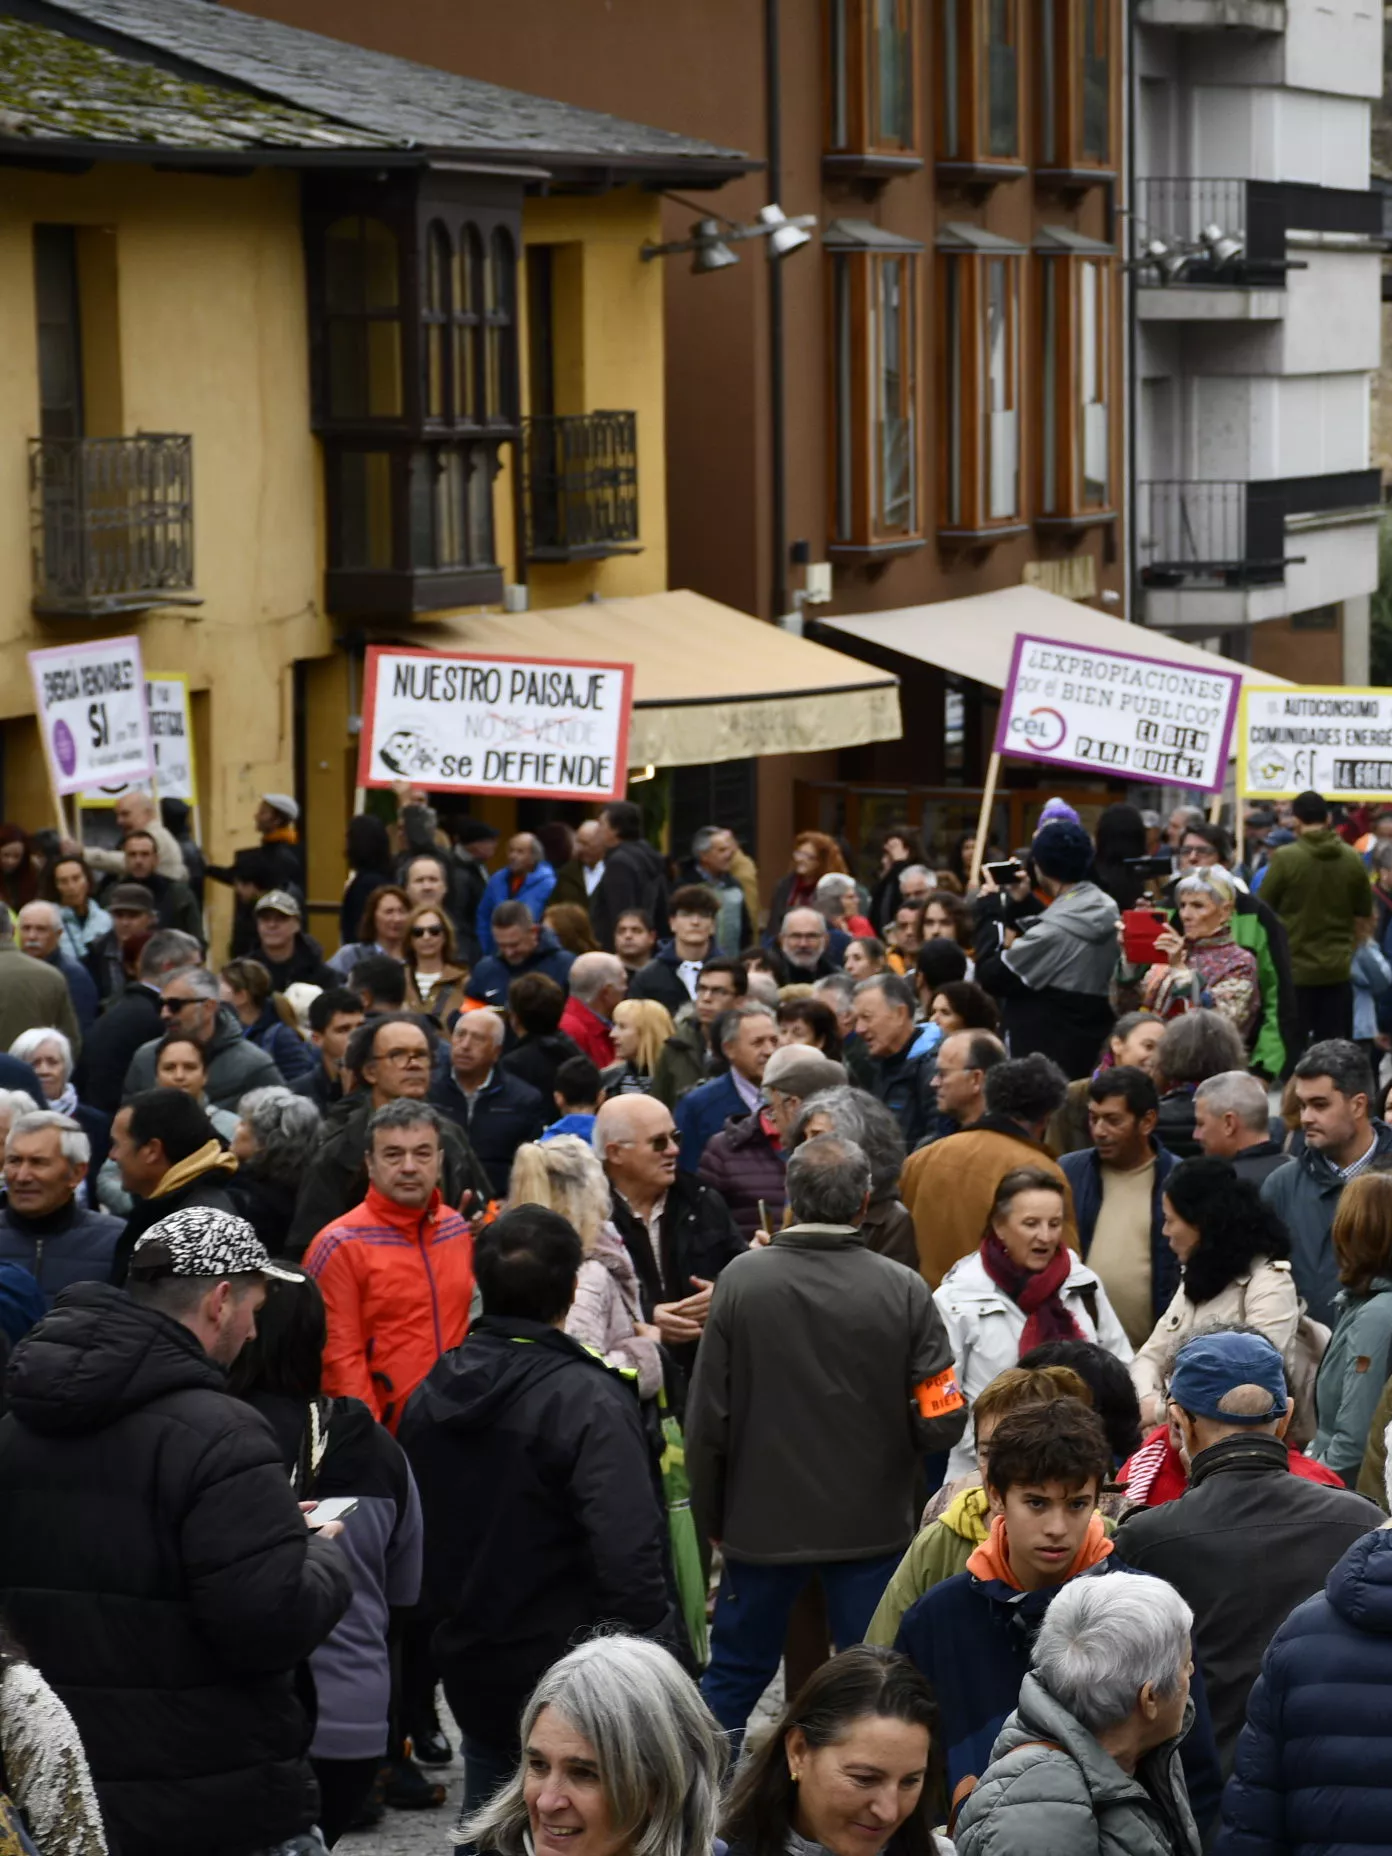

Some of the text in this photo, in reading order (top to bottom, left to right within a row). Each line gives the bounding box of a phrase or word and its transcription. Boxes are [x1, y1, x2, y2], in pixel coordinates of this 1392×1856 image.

[393, 663, 605, 710] NUESTRO PAISAJE
[1028, 649, 1225, 701] ¿EXPROPIACIONES
[1061, 682, 1114, 708] BIEN
[1284, 697, 1379, 718] AUTOCONSUMO
[464, 714, 495, 738] NO
[1250, 726, 1341, 744] COMUNIDADES
[440, 750, 611, 788] se DEFIENDE
